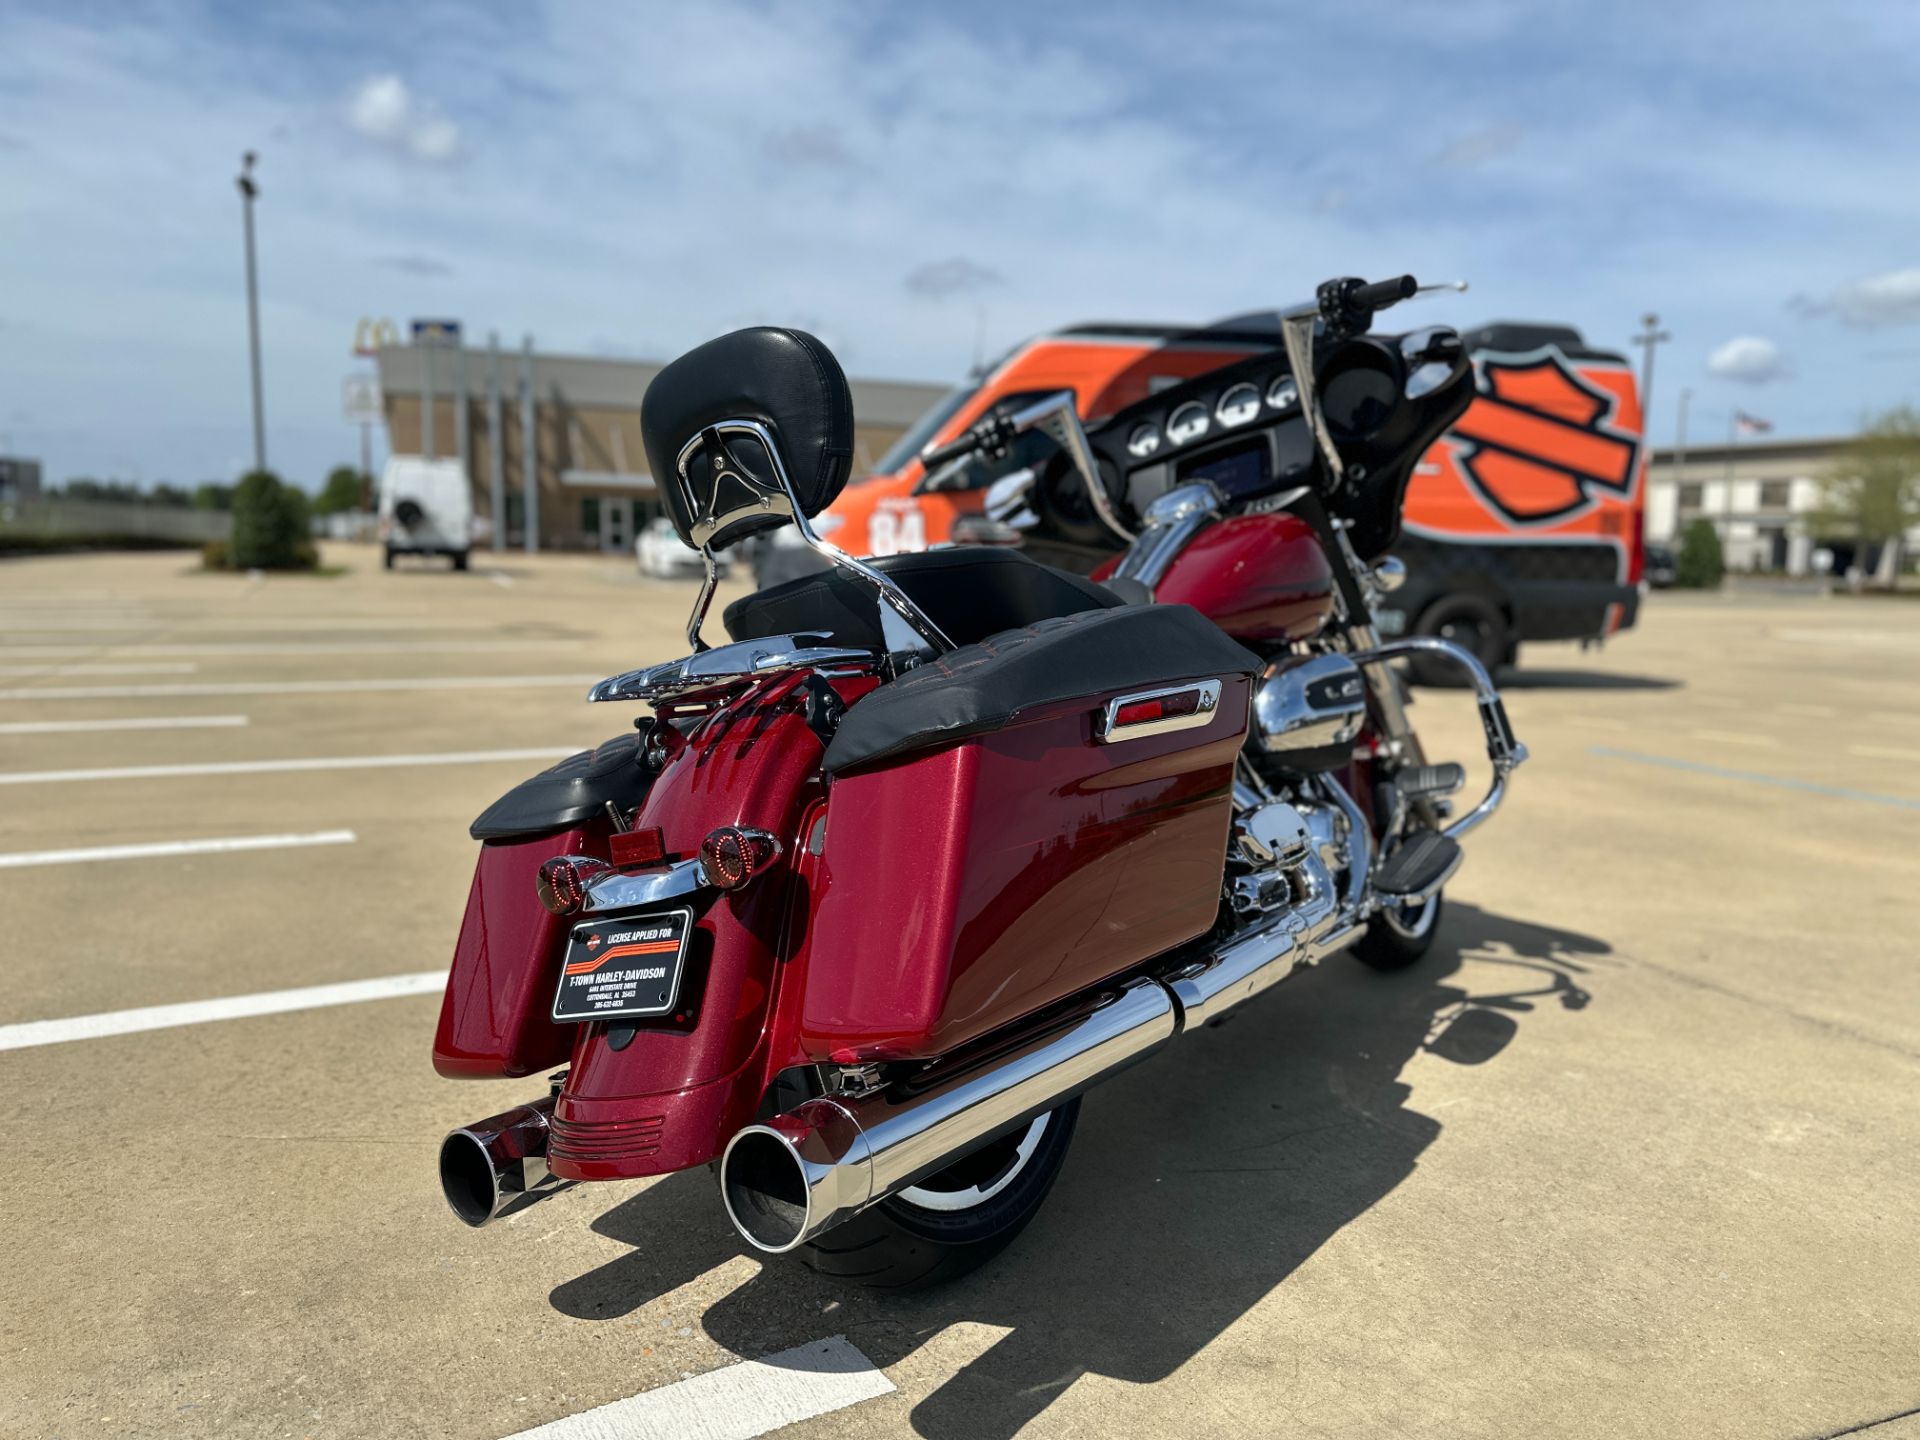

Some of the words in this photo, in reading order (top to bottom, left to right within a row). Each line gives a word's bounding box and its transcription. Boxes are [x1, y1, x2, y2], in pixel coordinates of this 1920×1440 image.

[607, 933, 631, 944] LICENSE
[631, 931, 657, 941] APPLIED
[658, 928, 672, 938] FOR
[569, 974, 595, 987] T-TOWN
[595, 967, 666, 983] HARLEY-DAVIDSON
[624, 982, 638, 990] DRIVE
